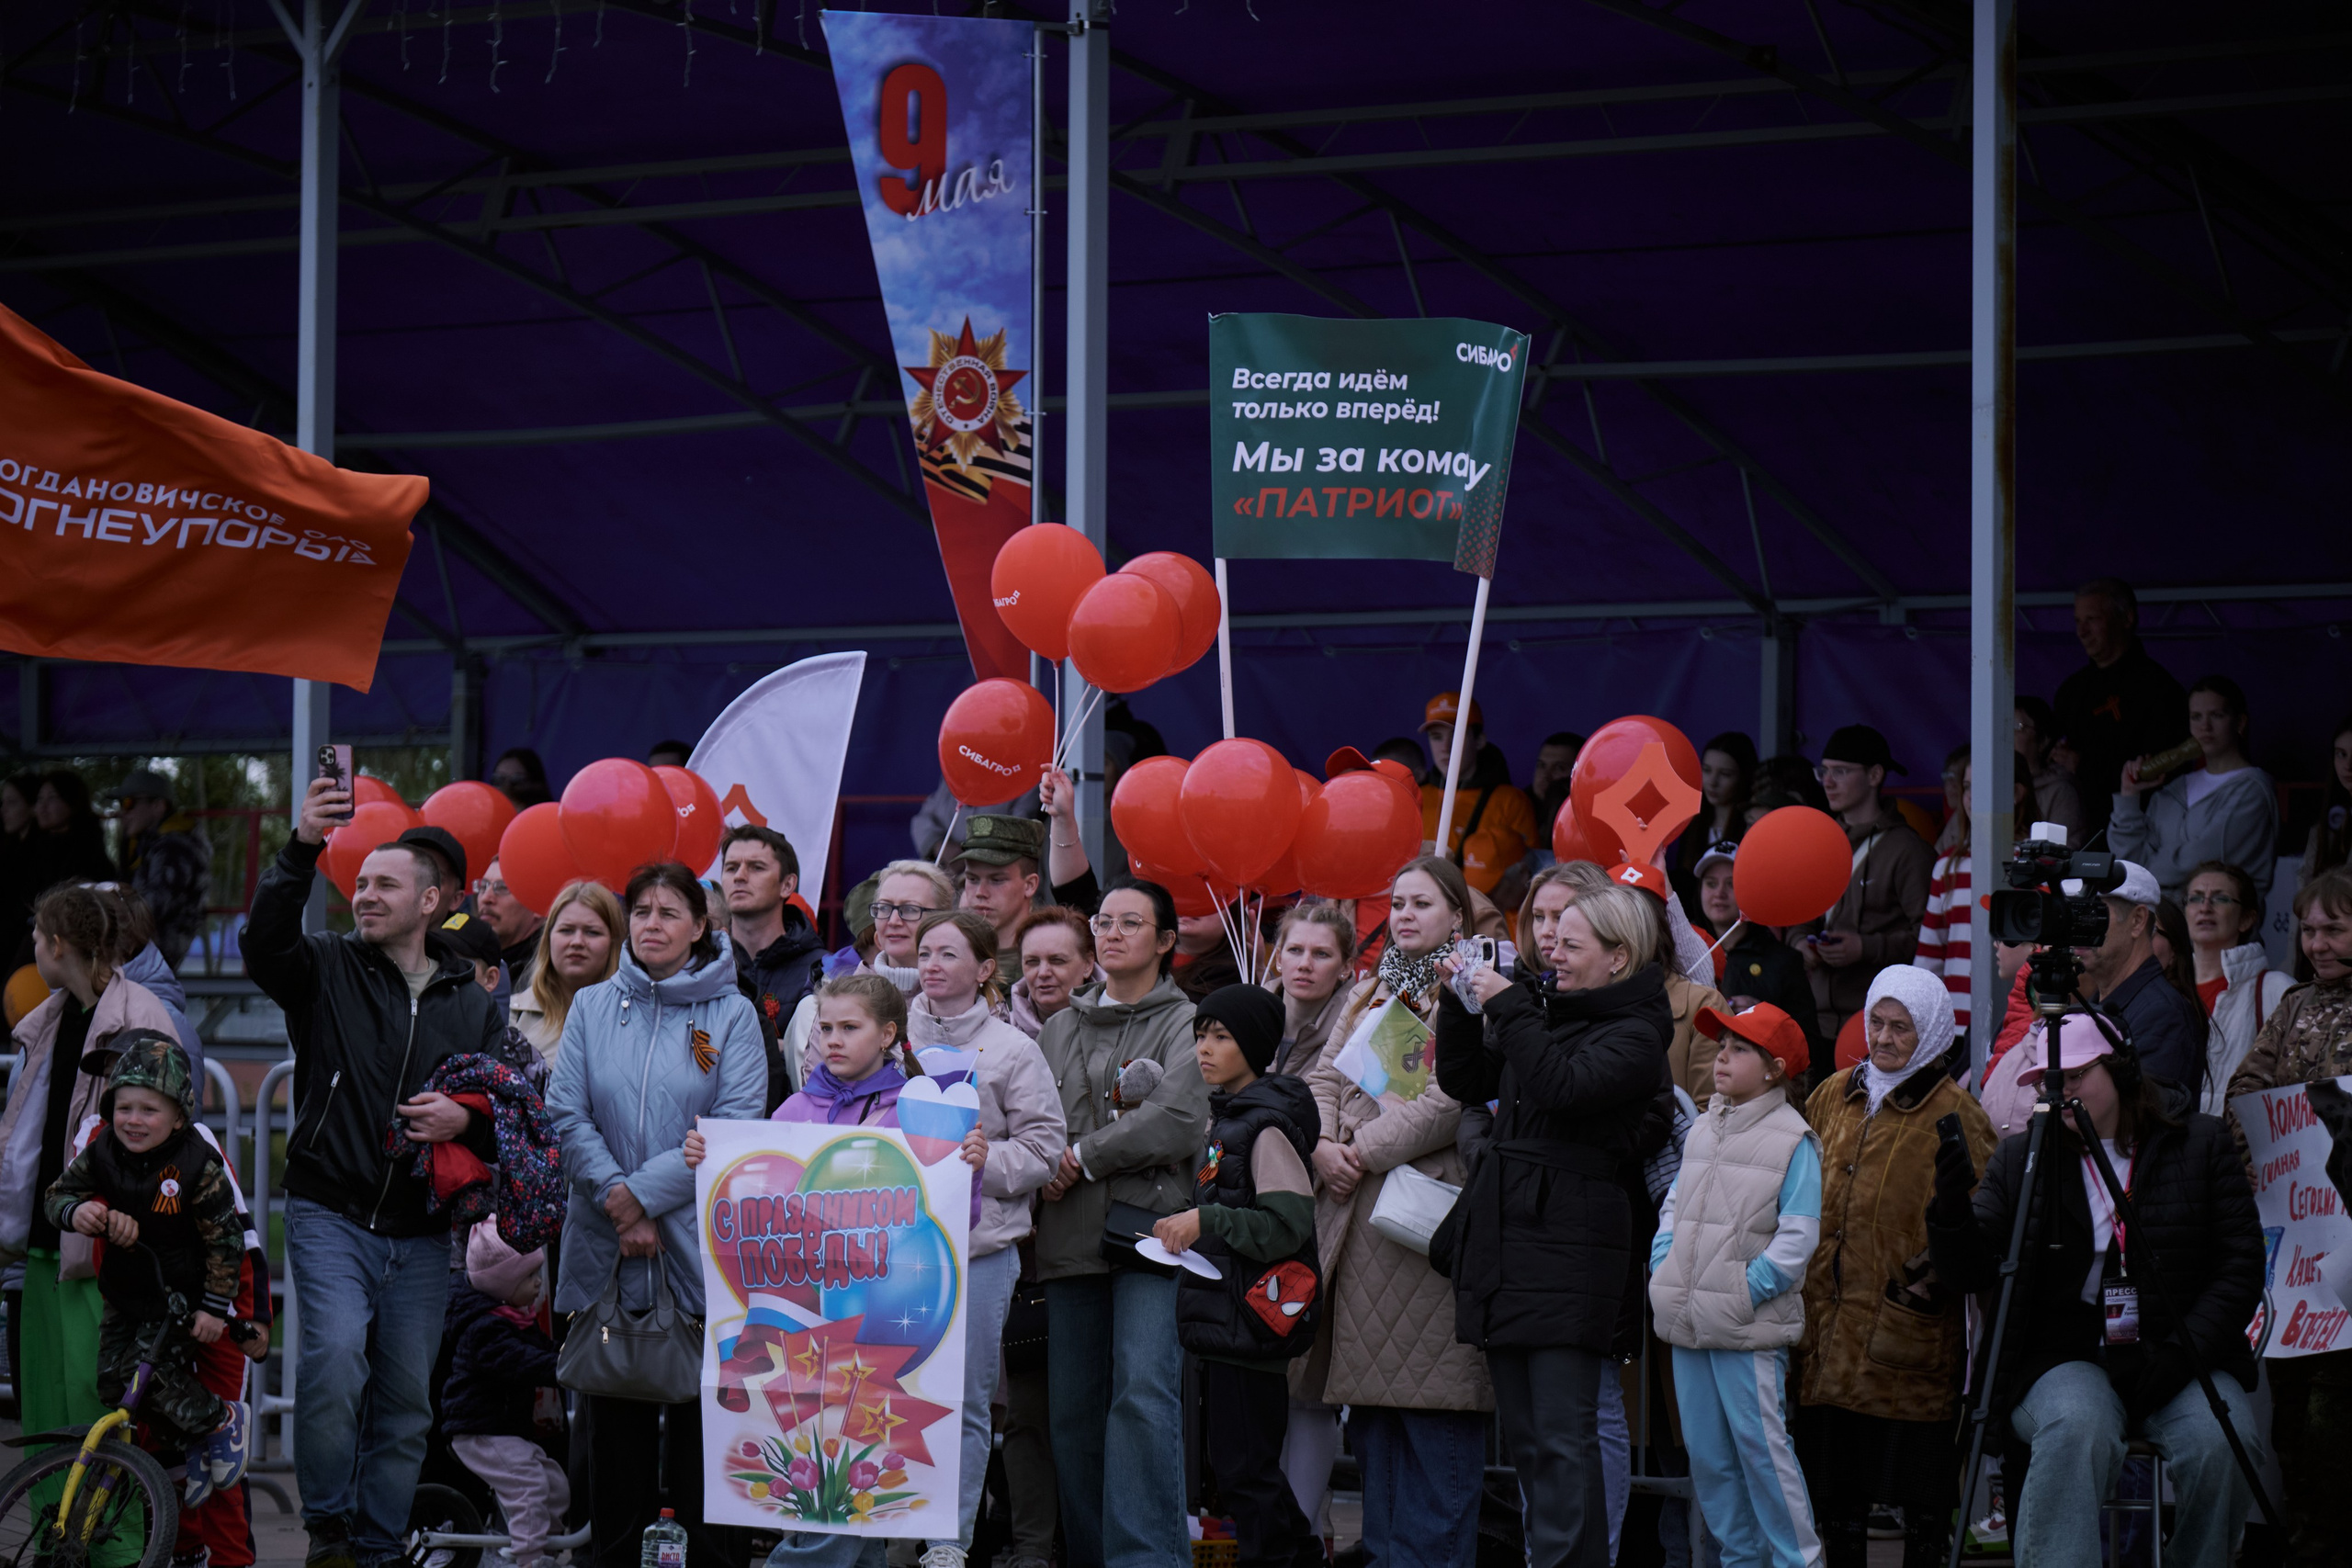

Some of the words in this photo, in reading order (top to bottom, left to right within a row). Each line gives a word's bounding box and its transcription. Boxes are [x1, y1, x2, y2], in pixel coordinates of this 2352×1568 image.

[879, 64, 948, 217] 9
[906, 159, 1017, 222] мая
[935, 357, 993, 424] ОТЕЧЕСТВЕННАЯ
[1232, 367, 1331, 391] Всегда
[1338, 368, 1408, 392] идём
[1232, 400, 1329, 419] только
[1335, 398, 1441, 424] вперёд!
[1232, 441, 1305, 473] Мы
[1315, 446, 1366, 472] за
[1233, 487, 1463, 522] «ПАТРИОТ»
[958, 744, 1012, 776] СИБАГРО
[2262, 1091, 2318, 1143] КОМАН
[715, 1199, 733, 1240] С
[739, 1186, 919, 1238] ПРАЗДНИКОМ
[739, 1228, 890, 1290] ПОБЕДЫ!
[2285, 1244, 2331, 1288] КАДЕТ
[2106, 1287, 2138, 1296] ПРЕСС
